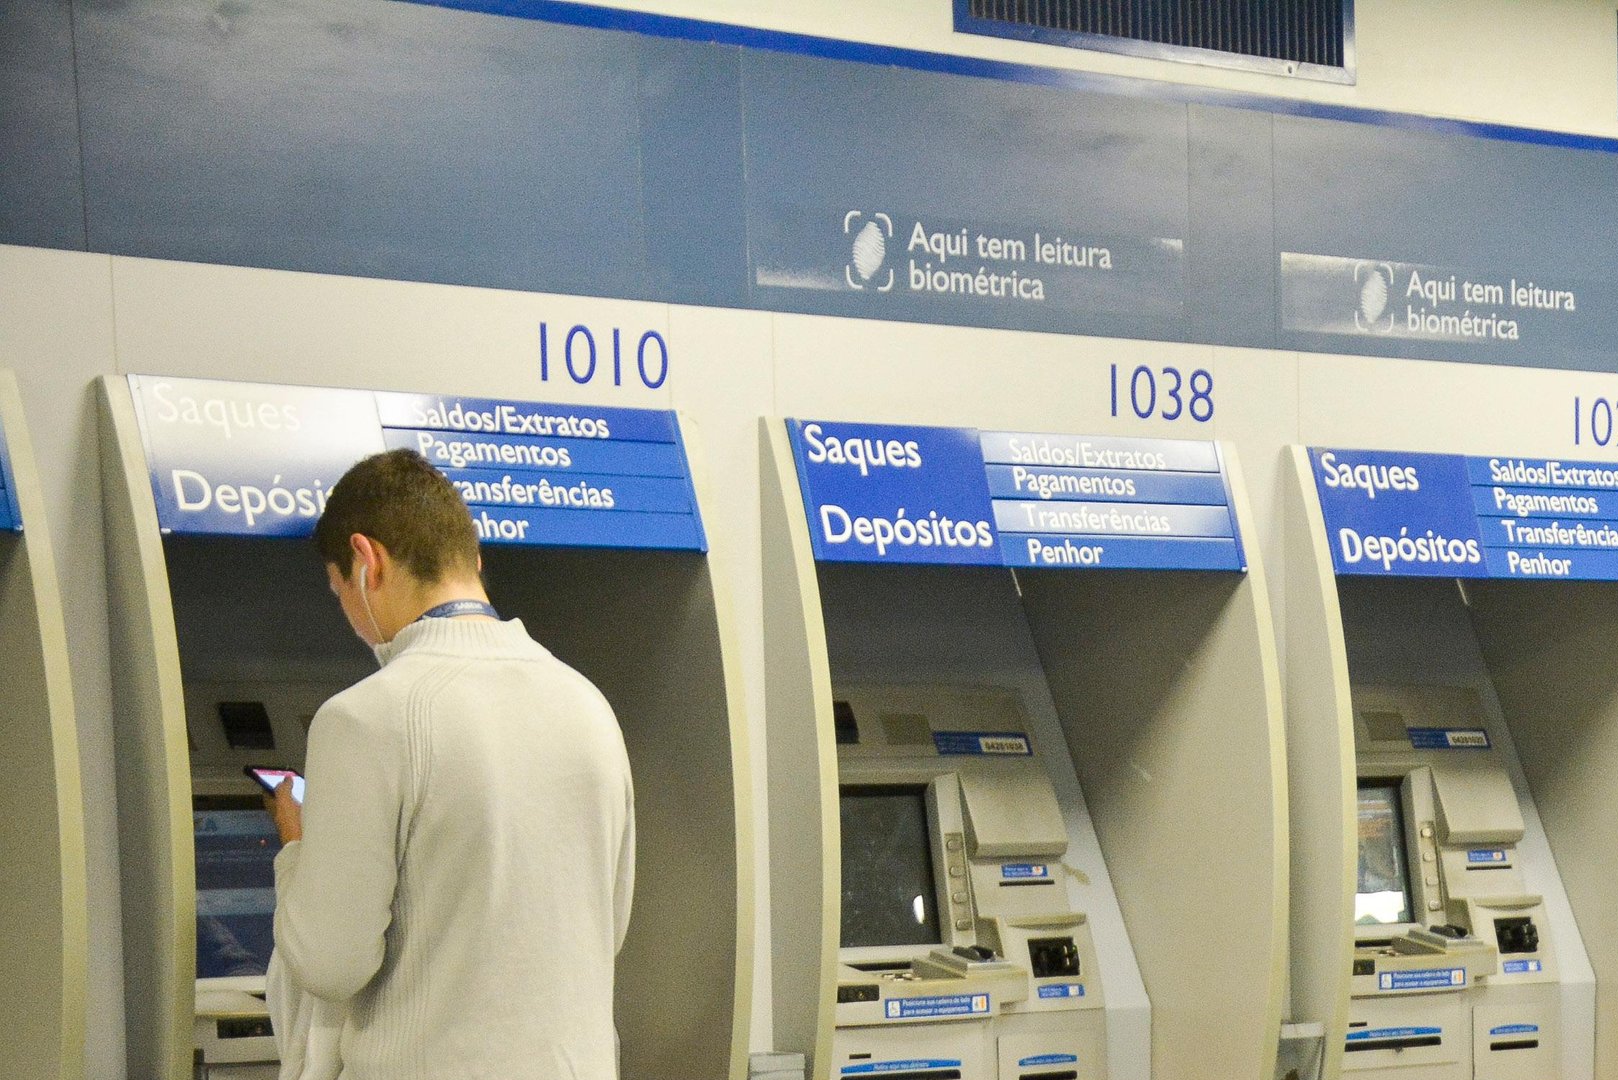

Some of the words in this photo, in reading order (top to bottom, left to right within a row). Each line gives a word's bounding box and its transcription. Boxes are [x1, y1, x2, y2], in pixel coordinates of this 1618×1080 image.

[907, 221, 967, 263] Aqui
[976, 234, 1025, 261] tem
[1035, 233, 1112, 269] leitura
[909, 259, 1045, 300] biométrica
[1406, 270, 1455, 308] Aqui
[1463, 281, 1503, 304] tem
[1511, 279, 1575, 311] leitura
[1407, 305, 1519, 340] biométrica
[538, 321, 669, 390] 1010
[153, 382, 301, 439] Saques
[1109, 363, 1215, 423] 1038
[415, 399, 610, 439] Saldos/Extratos
[417, 432, 572, 468] Pagamentos
[804, 425, 922, 476] Saques
[1009, 438, 1166, 470] Saldos/Extratos
[443, 472, 615, 509] ransferências
[1013, 467, 1136, 499] Pagamentos
[1320, 452, 1419, 499] Saques
[171, 468, 335, 528] Depósi
[1021, 502, 1171, 533] Transferências
[1494, 487, 1599, 515] Pagamentos
[472, 511, 530, 540] nhor
[819, 504, 994, 556] Depósitos
[1029, 539, 1103, 565] Penhor
[1339, 527, 1481, 570] Depósitos
[1508, 551, 1572, 577] Penhor
